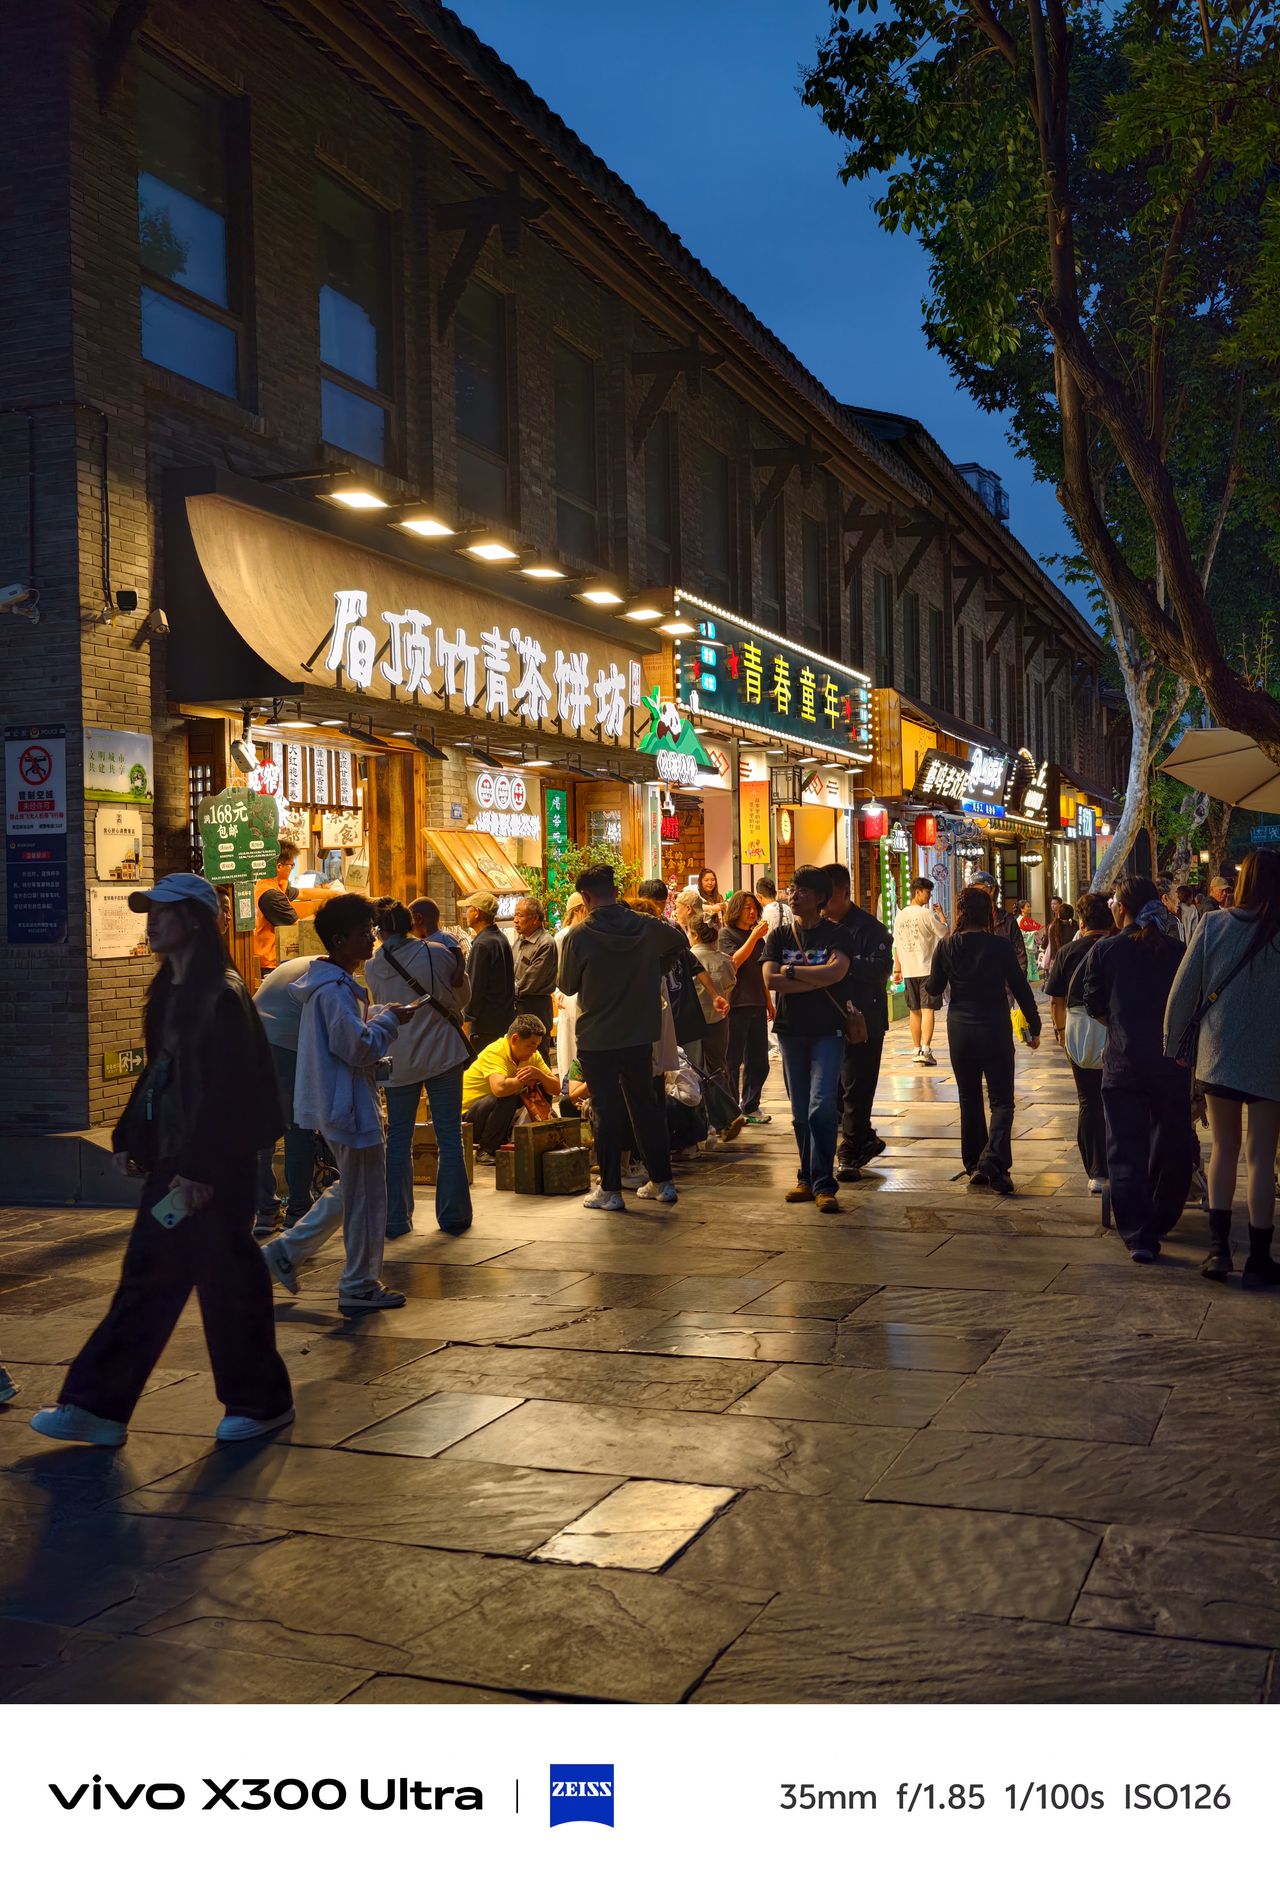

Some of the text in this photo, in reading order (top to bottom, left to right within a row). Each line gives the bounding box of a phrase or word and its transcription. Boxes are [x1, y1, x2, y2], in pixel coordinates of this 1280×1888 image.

[743, 641, 840, 729] 青春童年
[89, 750, 125, 763] 文明城市
[19, 790, 54, 800] 管制空域
[23, 801, 50, 811] 未经许可
[217, 824, 239, 838] 包邮
